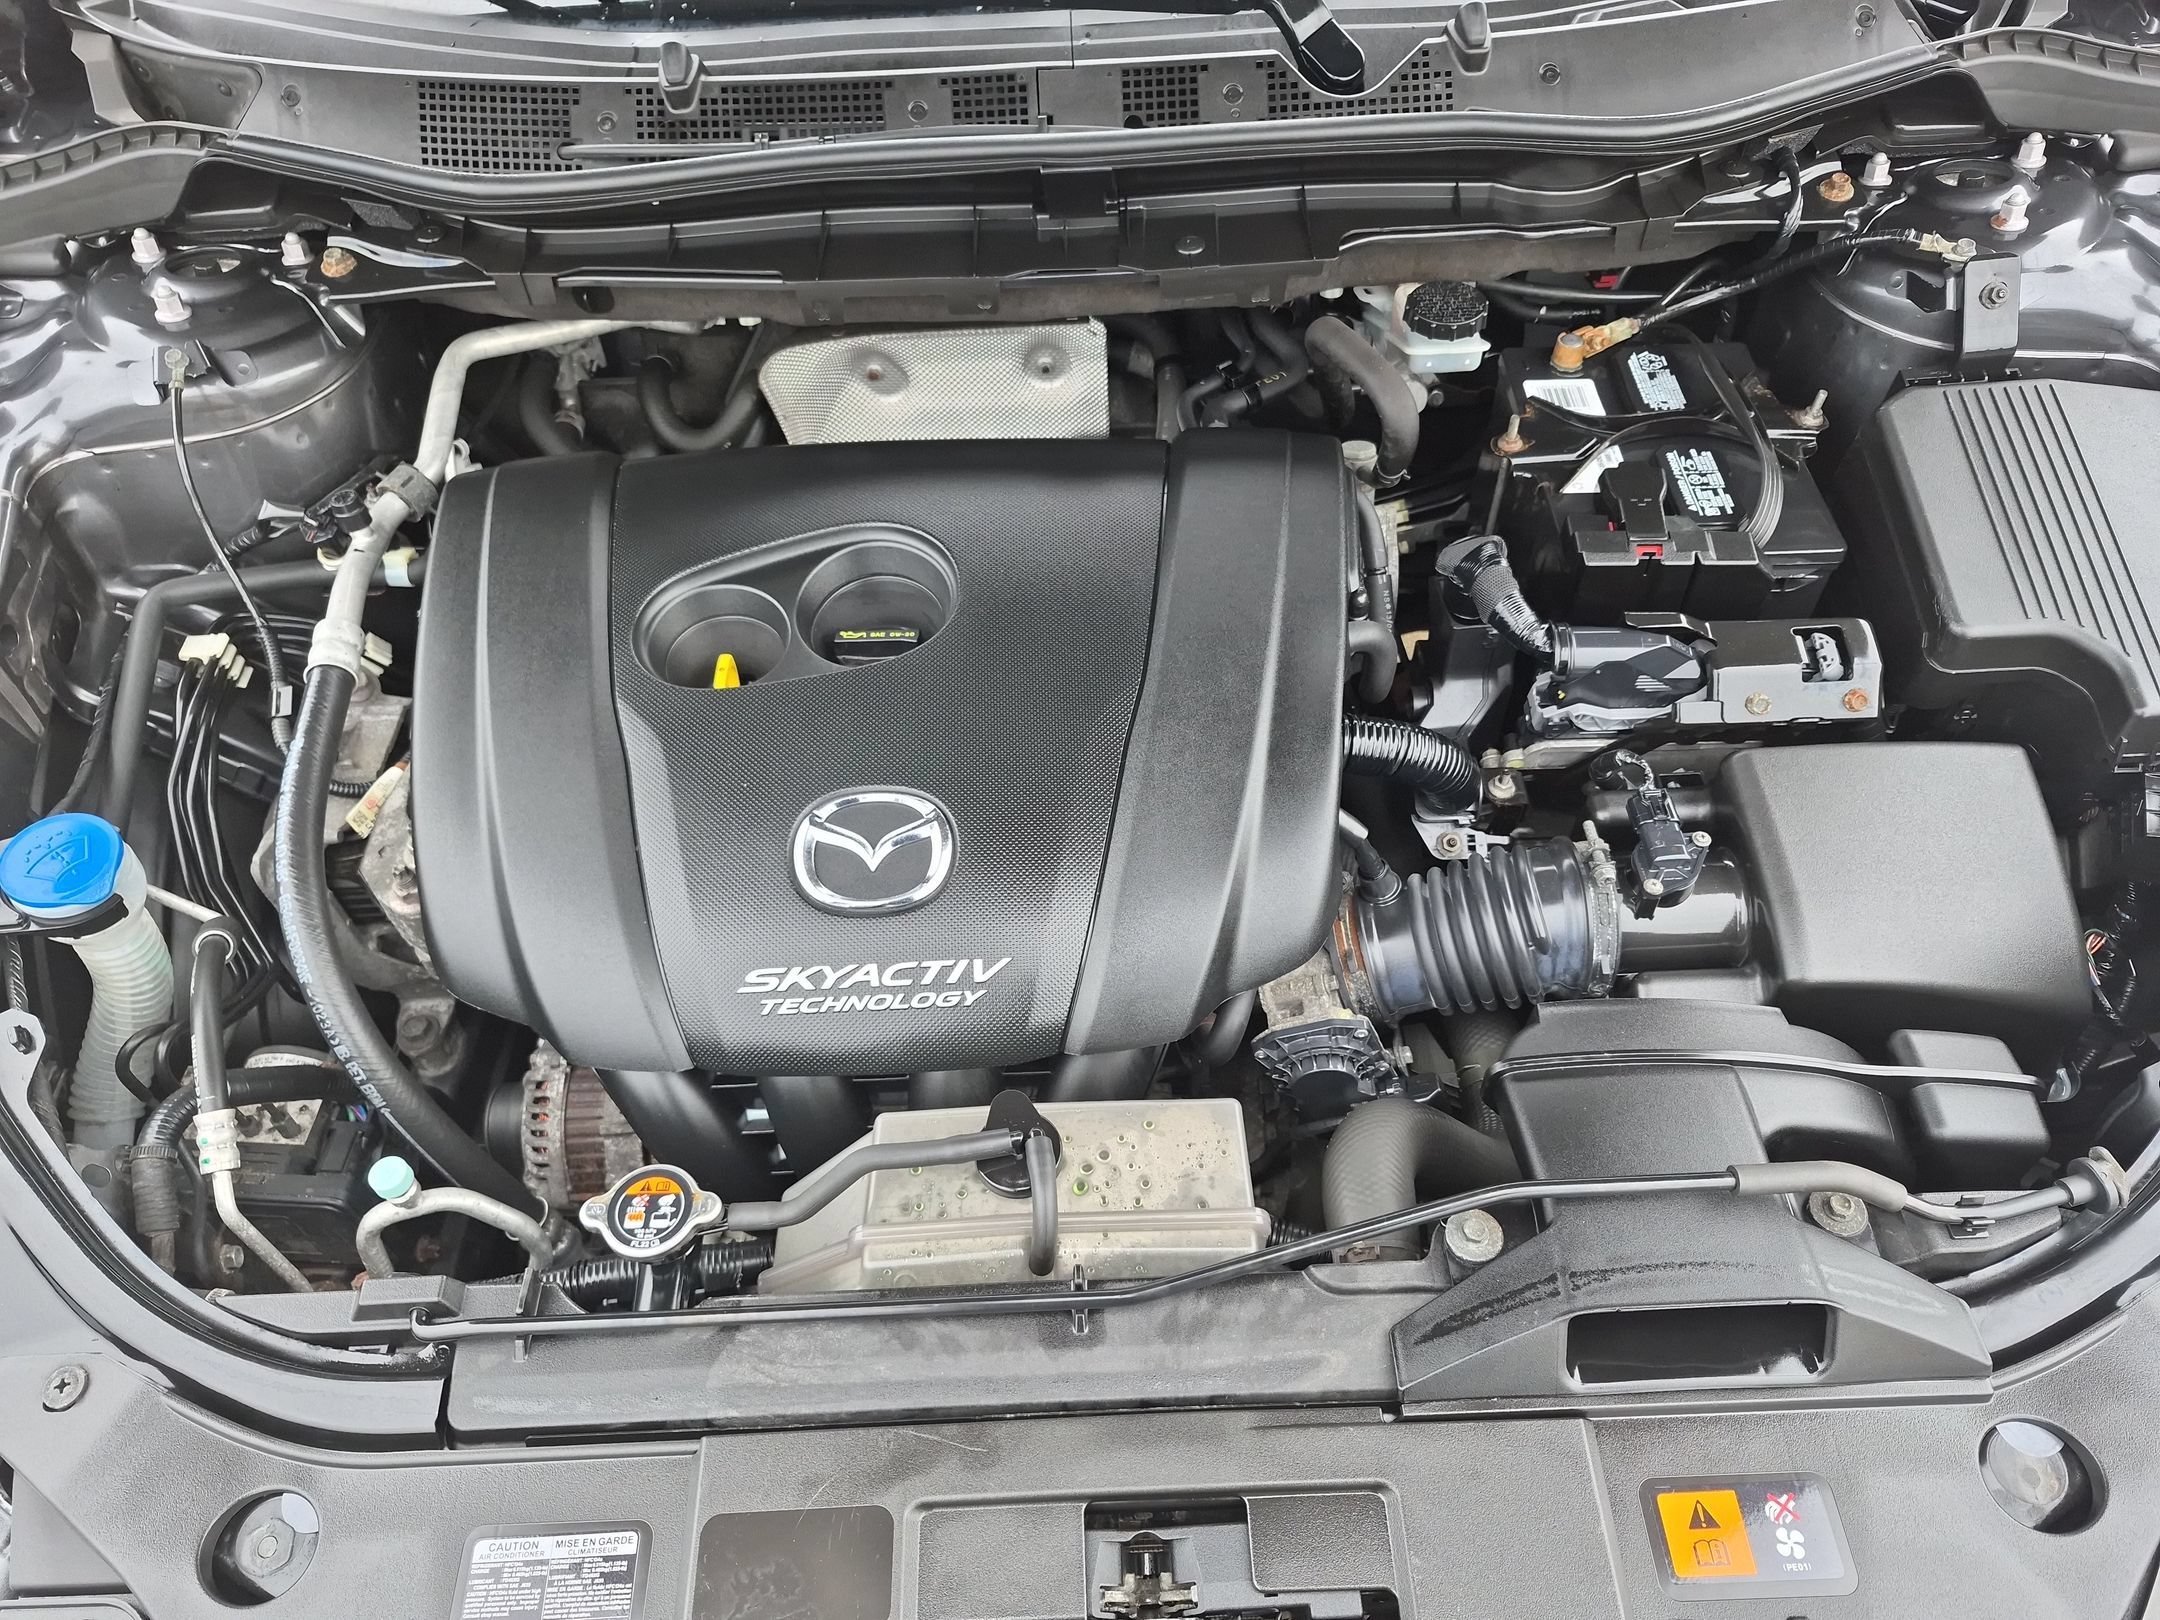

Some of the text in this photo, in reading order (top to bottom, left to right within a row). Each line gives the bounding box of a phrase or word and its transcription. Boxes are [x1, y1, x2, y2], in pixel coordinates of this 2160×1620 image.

[736, 957, 1013, 994] SKYACTIV
[760, 989, 989, 1016] TECHNOLOGY
[488, 1541, 540, 1552] CAUTION
[555, 1536, 634, 1548] MISE EN GARDE
[493, 1550, 545, 1559] CONDITIONER
[567, 1546, 618, 1556] CLIMATISEUR
[1782, 1562, 1812, 1572] (PE01)
